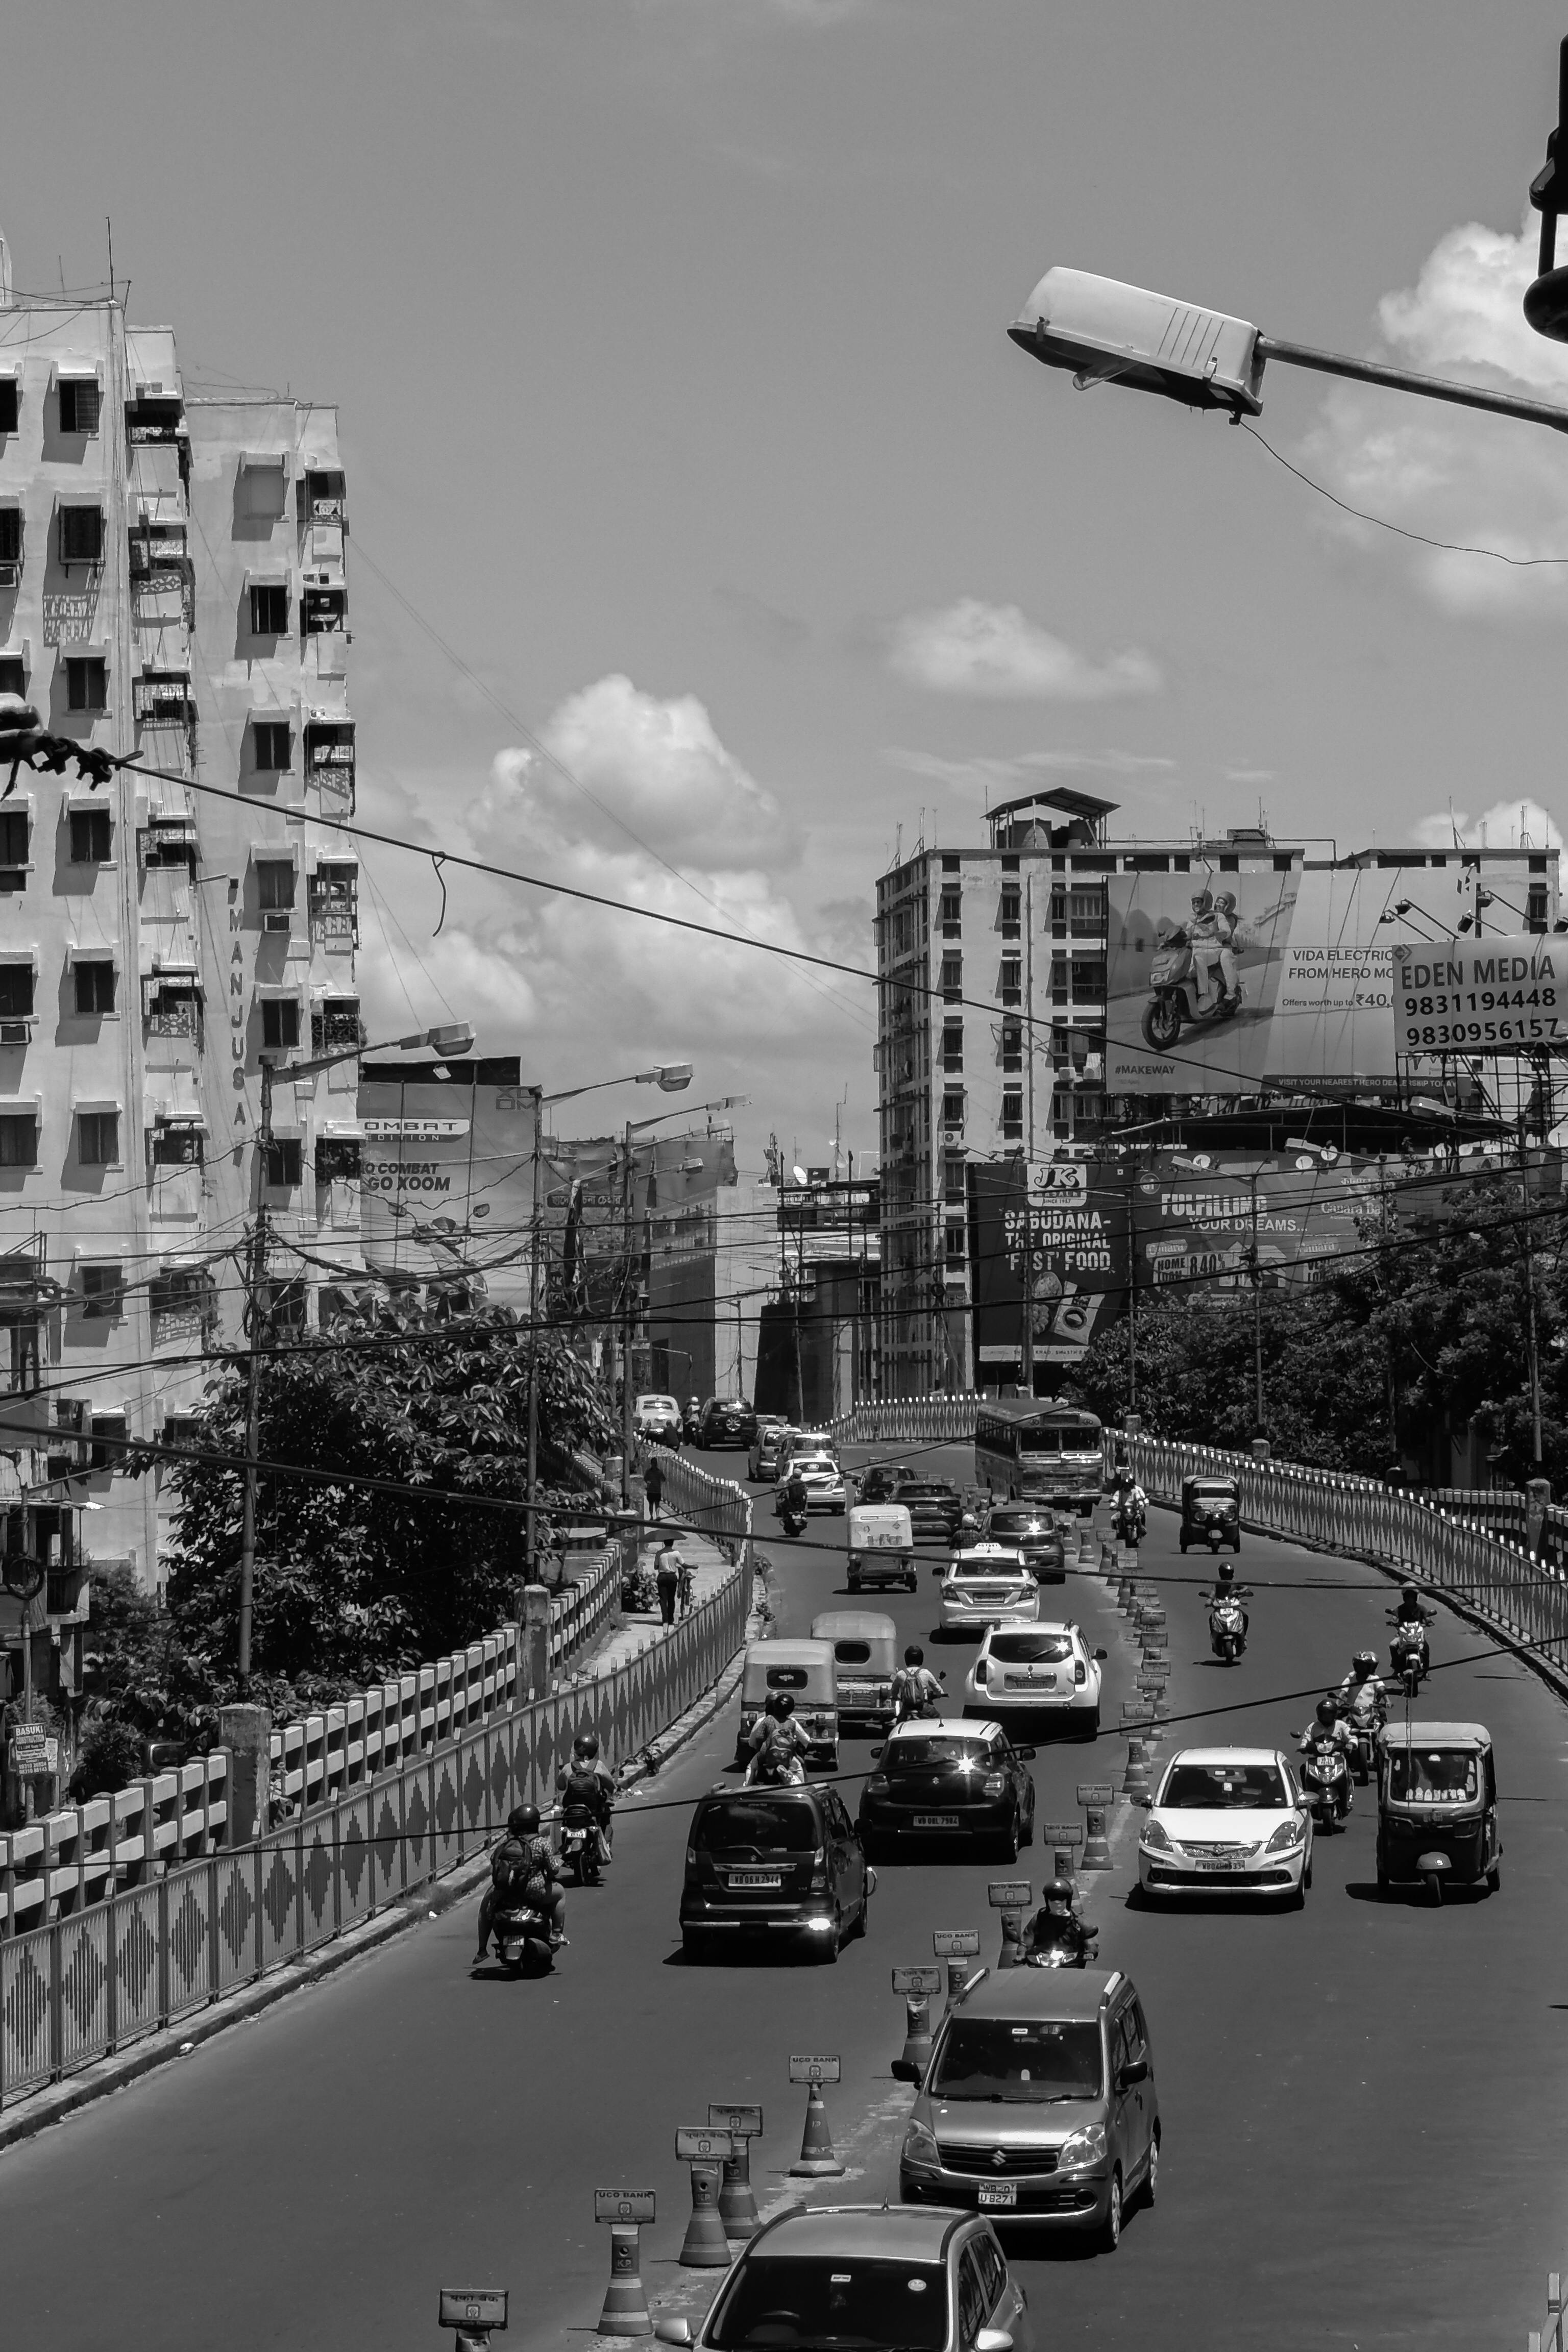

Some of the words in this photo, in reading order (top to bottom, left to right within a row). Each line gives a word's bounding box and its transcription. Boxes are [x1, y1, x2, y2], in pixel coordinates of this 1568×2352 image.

[1293, 950, 1325, 961] VIDA
[1289, 968, 1328, 978] FROM
[1332, 968, 1371, 978] HERO
[1402, 961, 1463, 990] EDEN
[1474, 955, 1556, 984] MEDIA
[1282, 998, 1307, 1007] Offers
[1334, 1000, 1343, 1009] up
[1405, 987, 1556, 1017] 9831194448
[229, 908, 246, 1125] MANJUSA
[1406, 1018, 1559, 1046] 9830956157
[1115, 1065, 1175, 1074] #MAKEWAY
[364, 1122, 458, 1131] OMBAT
[378, 1162, 439, 1174] COMBAT
[368, 1177, 393, 1191] GO
[397, 1177, 451, 1191] XOOM
[1034, 1167, 1080, 1189] JK
[1189, 1217, 1231, 1230] YOUR
[1005, 1232, 1035, 1248] THE
[1042, 1232, 1111, 1249] ORIGINAL
[1065, 1251, 1111, 1271] FOOD
[1158, 1257, 1185, 1270] HOME
[16, 1725, 43, 1736] BASUKI
[617, 2259, 632, 2267] KP
